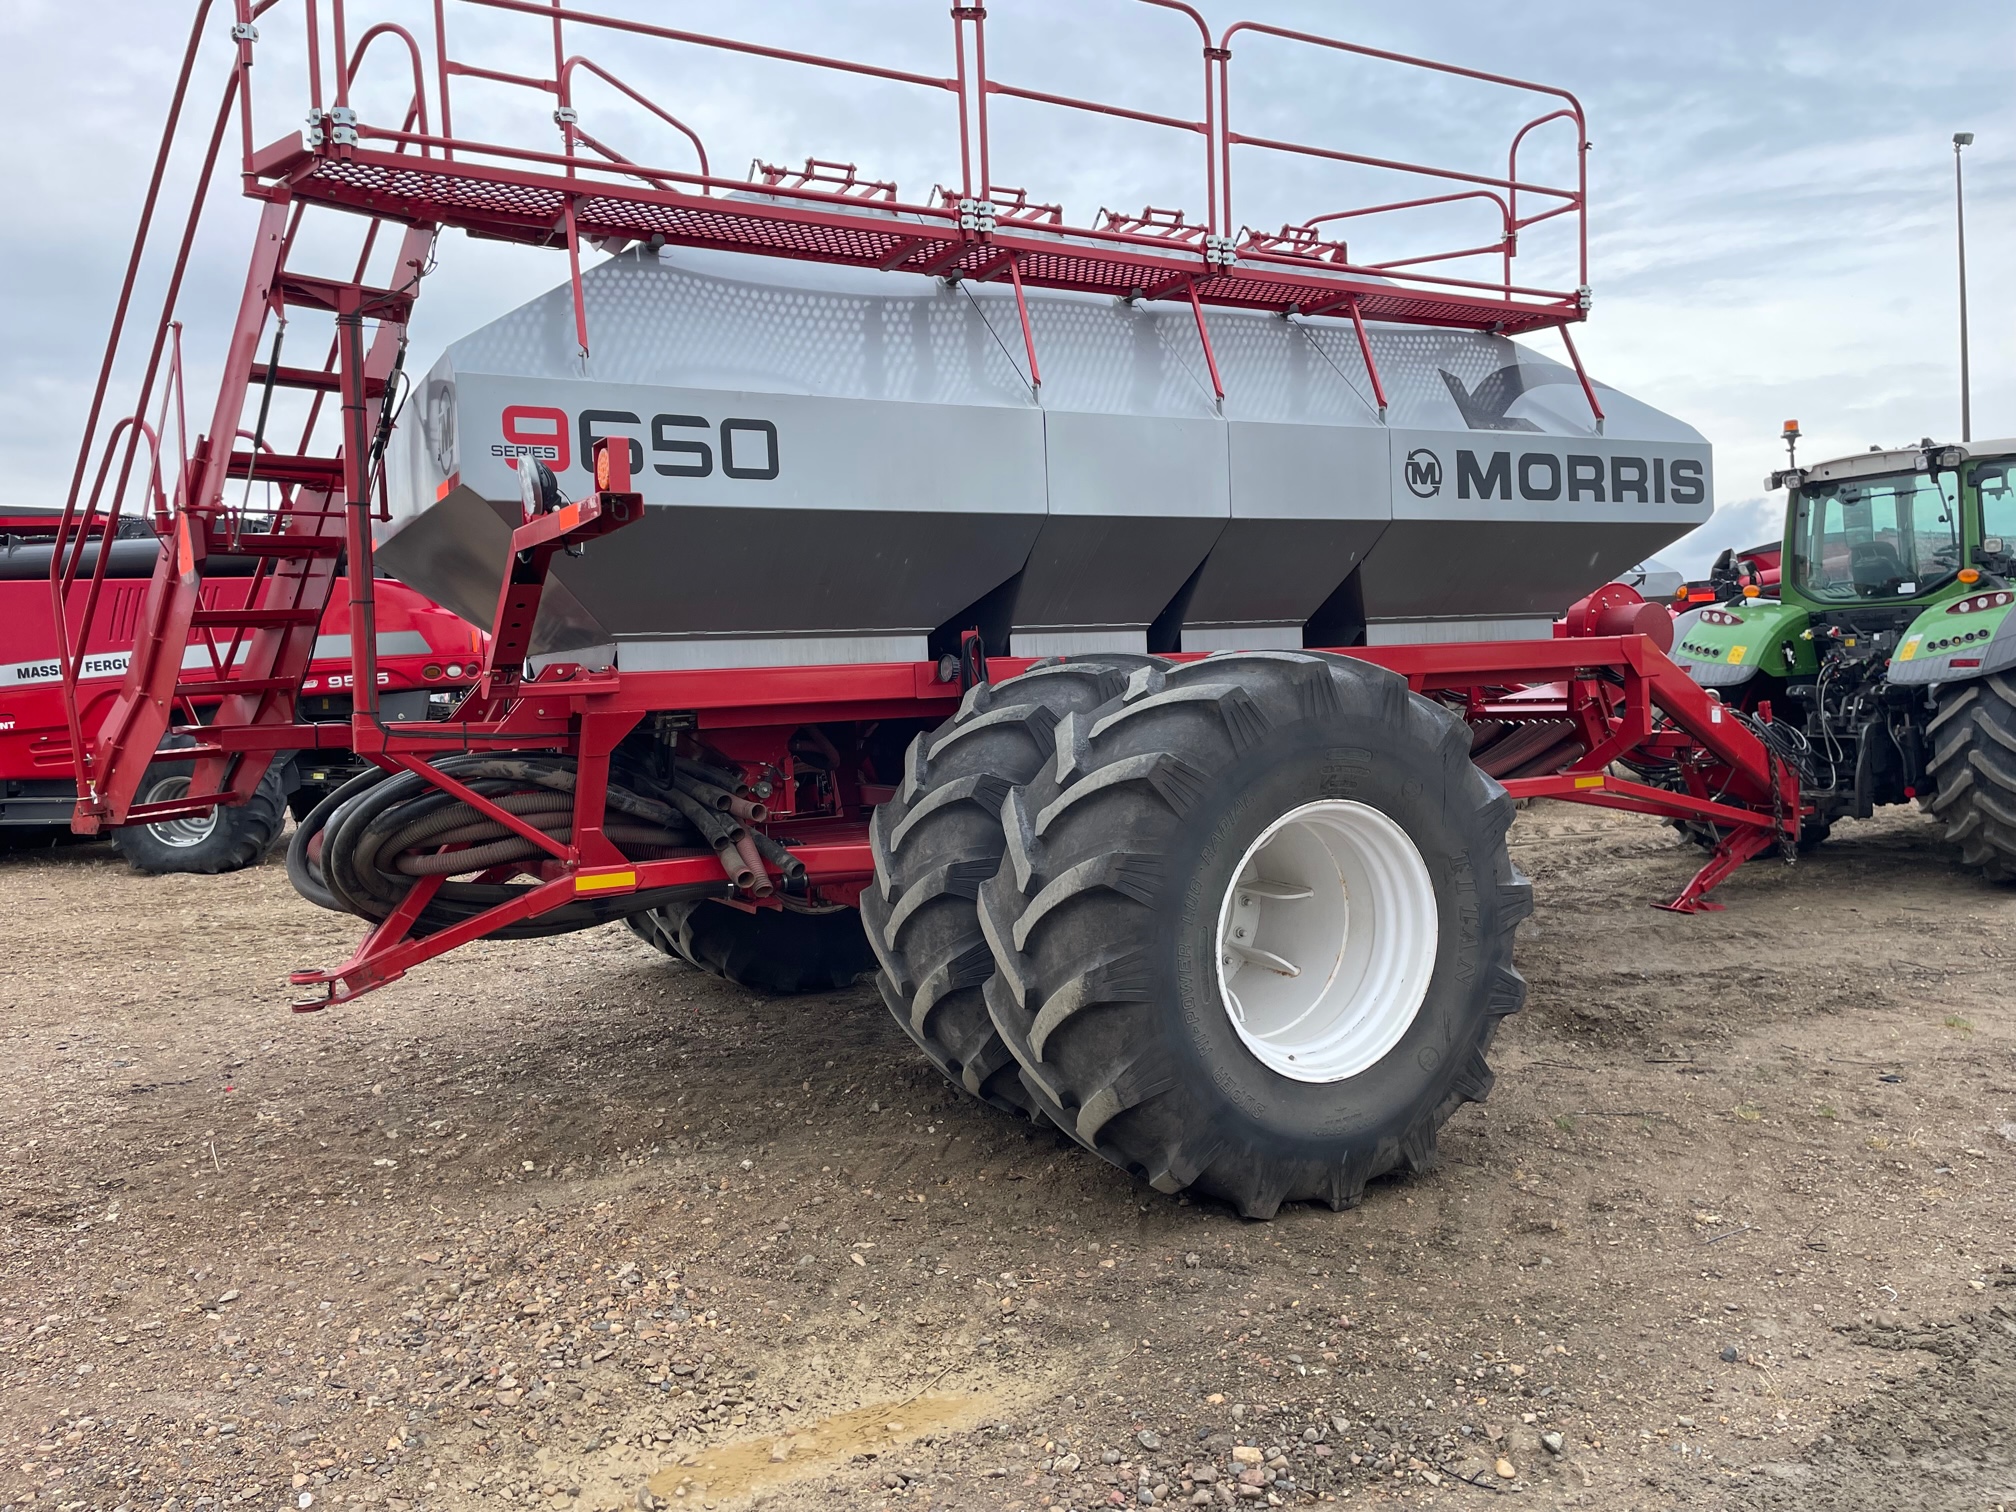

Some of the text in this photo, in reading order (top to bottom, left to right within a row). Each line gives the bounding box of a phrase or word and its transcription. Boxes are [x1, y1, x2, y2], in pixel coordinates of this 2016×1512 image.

[491, 444, 556, 459] SERIES
[502, 405, 780, 480] 9650
[1456, 449, 1705, 504] MORRIS
[17, 658, 130, 679] MASS FERGU
[328, 672, 389, 688] 955
[1448, 847, 1483, 992] TITAN
[1177, 791, 1265, 1119] SUPER HI-POWER LUG RADIAL
